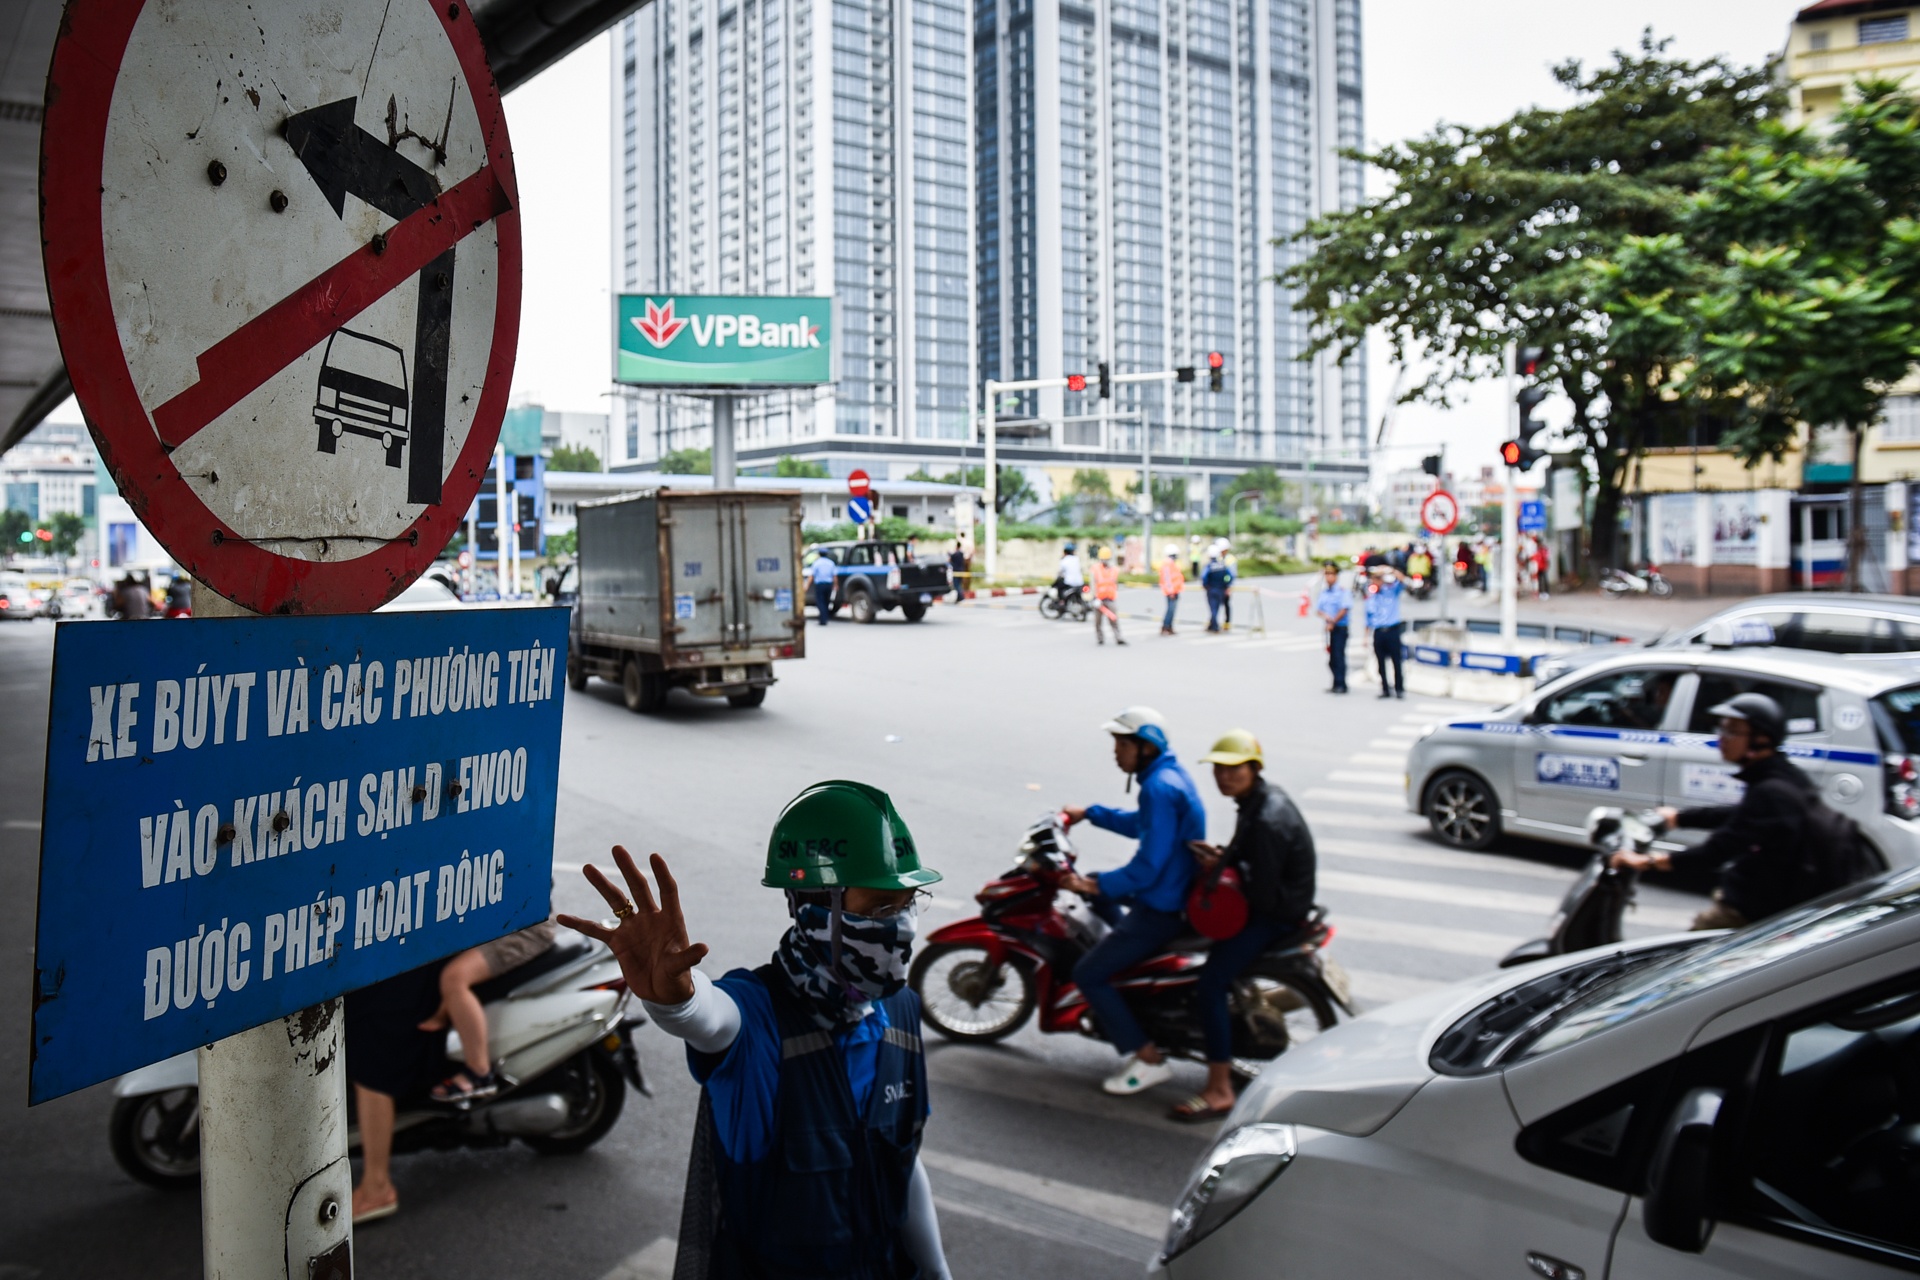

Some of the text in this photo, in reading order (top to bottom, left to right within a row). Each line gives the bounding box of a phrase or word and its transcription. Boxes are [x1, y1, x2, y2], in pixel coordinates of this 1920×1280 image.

[690, 313, 821, 348] VPBank
[86, 639, 556, 763] XE BÚYT VÀ CÁC PHƯƠNG TIỆN
[139, 799, 219, 888] VÀO
[231, 776, 348, 867] KHÁCH
[357, 766, 416, 840] SẠN
[778, 838, 848, 859] SN E&C
[143, 849, 505, 1021] ĐƯỢC PHÉP HOẠT ĐỘNG
